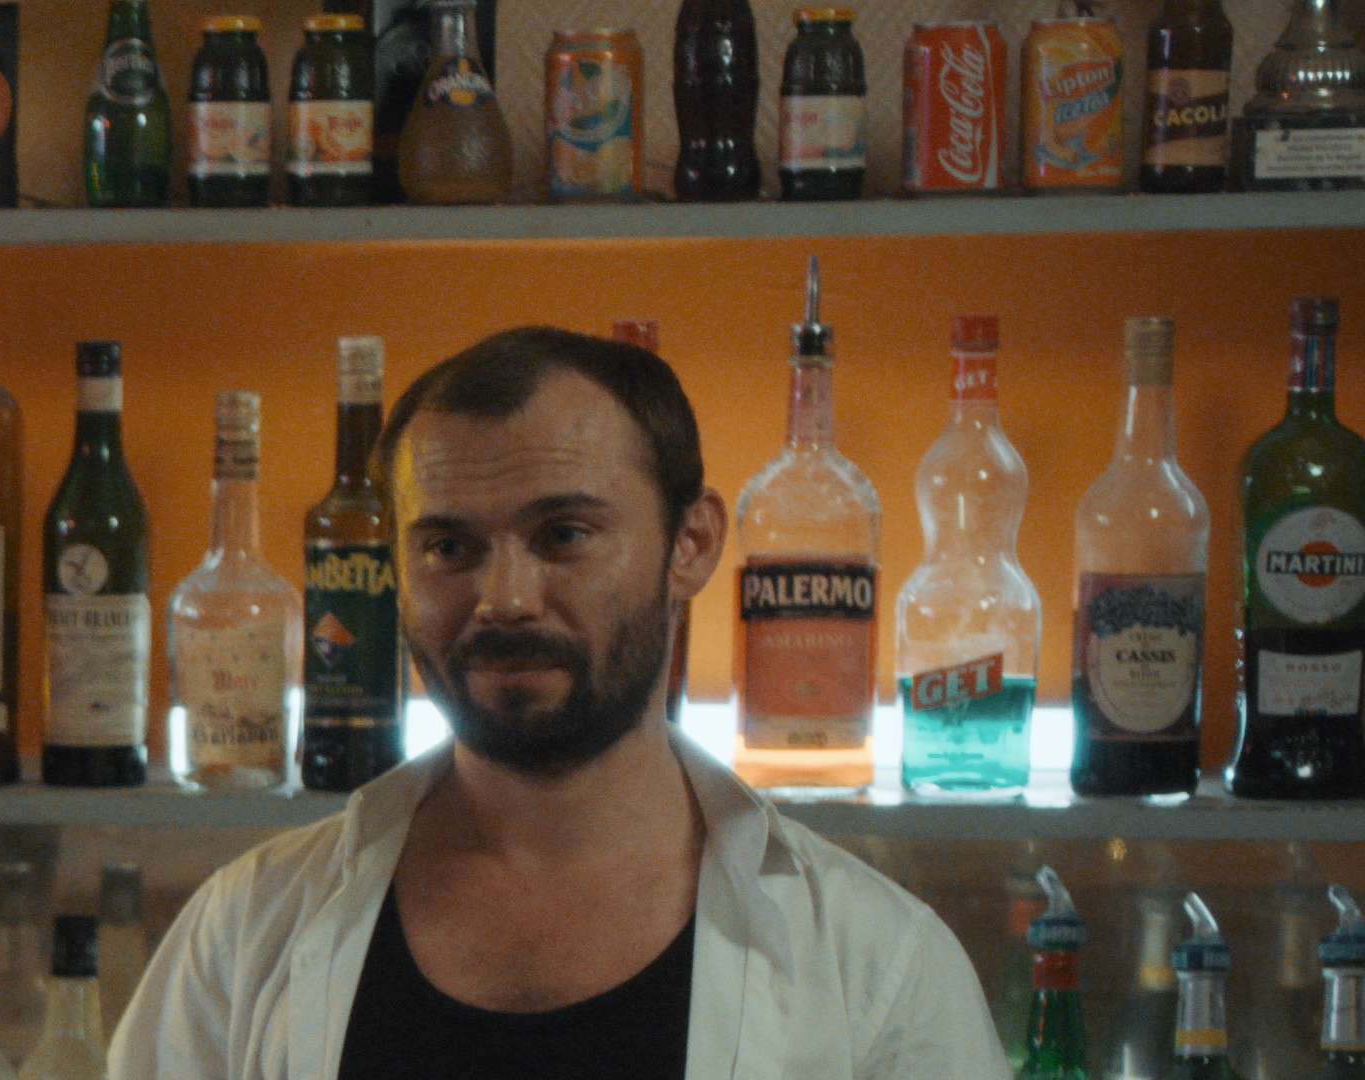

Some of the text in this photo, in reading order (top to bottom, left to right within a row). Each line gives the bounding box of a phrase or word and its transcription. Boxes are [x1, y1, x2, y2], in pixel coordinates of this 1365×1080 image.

[1044, 66, 1111, 98] Lipton
[1268, 553, 1365, 575] MARTINI
[743, 573, 874, 610] PALERMO
[1114, 649, 1177, 663] CASSIS
[917, 660, 996, 708] GET
